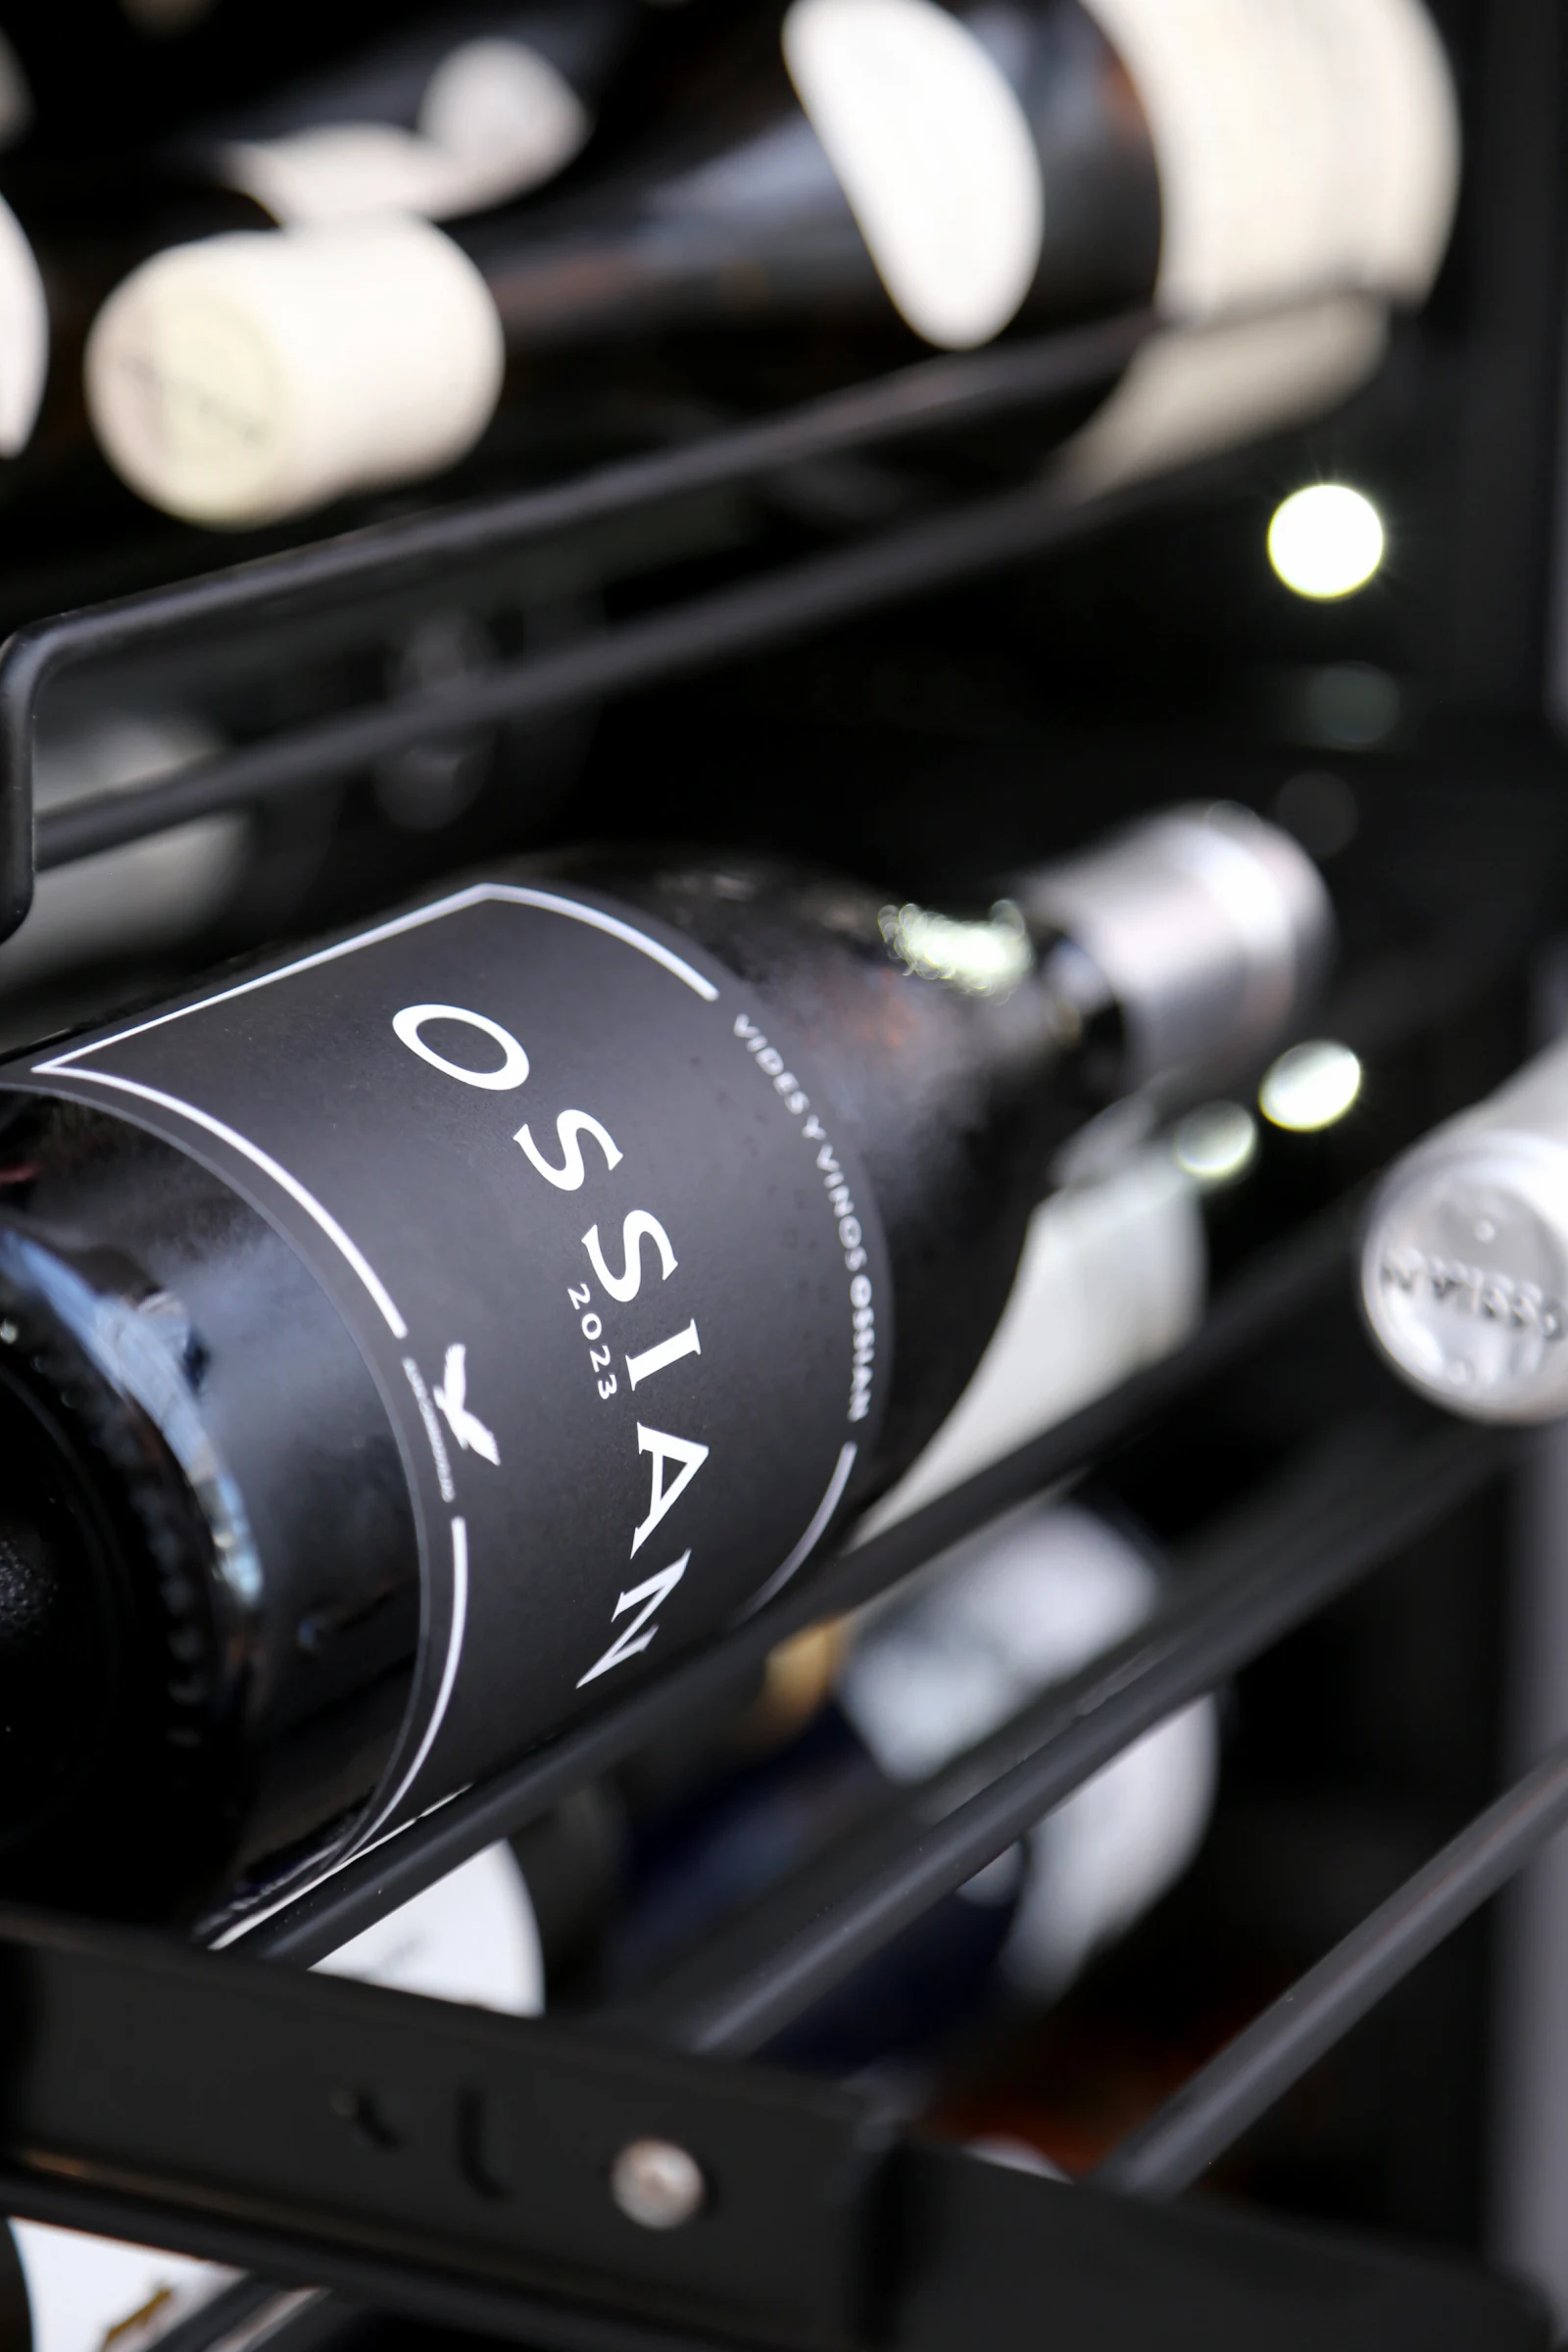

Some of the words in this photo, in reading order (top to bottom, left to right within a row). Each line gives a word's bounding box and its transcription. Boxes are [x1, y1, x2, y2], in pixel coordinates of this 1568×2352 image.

[392, 1004, 710, 1689] OSSIAN
[566, 1282, 618, 1399] 2023
[733, 1013, 810, 1114] VIDES
[802, 1114, 826, 1141] Y
[815, 1144, 867, 1272] VINOS
[849, 1274, 875, 1423] OSSIAN
